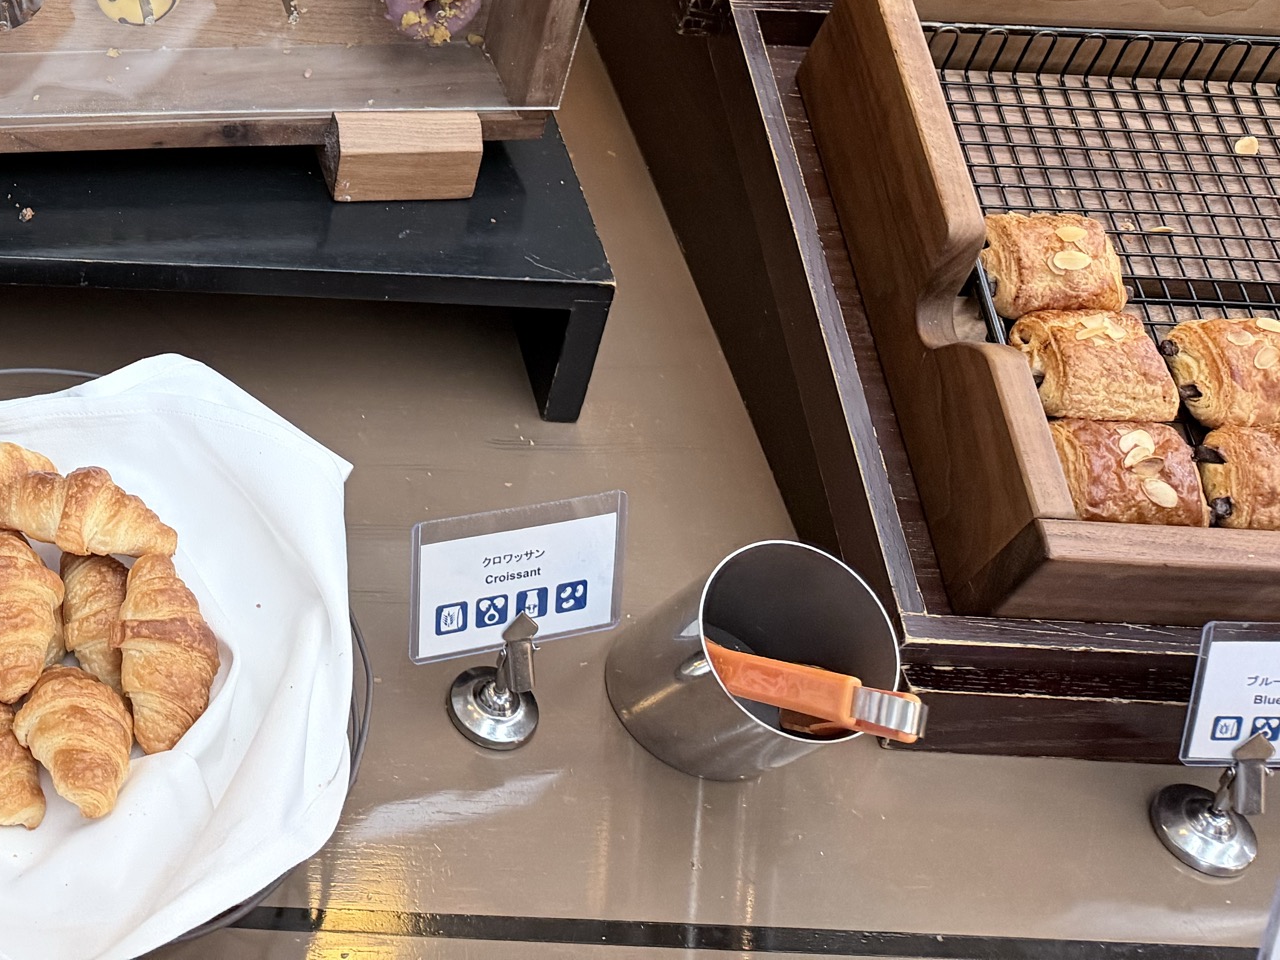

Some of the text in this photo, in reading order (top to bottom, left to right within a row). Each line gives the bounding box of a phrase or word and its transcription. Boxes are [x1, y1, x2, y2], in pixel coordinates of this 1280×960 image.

[482, 548, 546, 568] クロワッサン
[485, 566, 542, 584] Croissant
